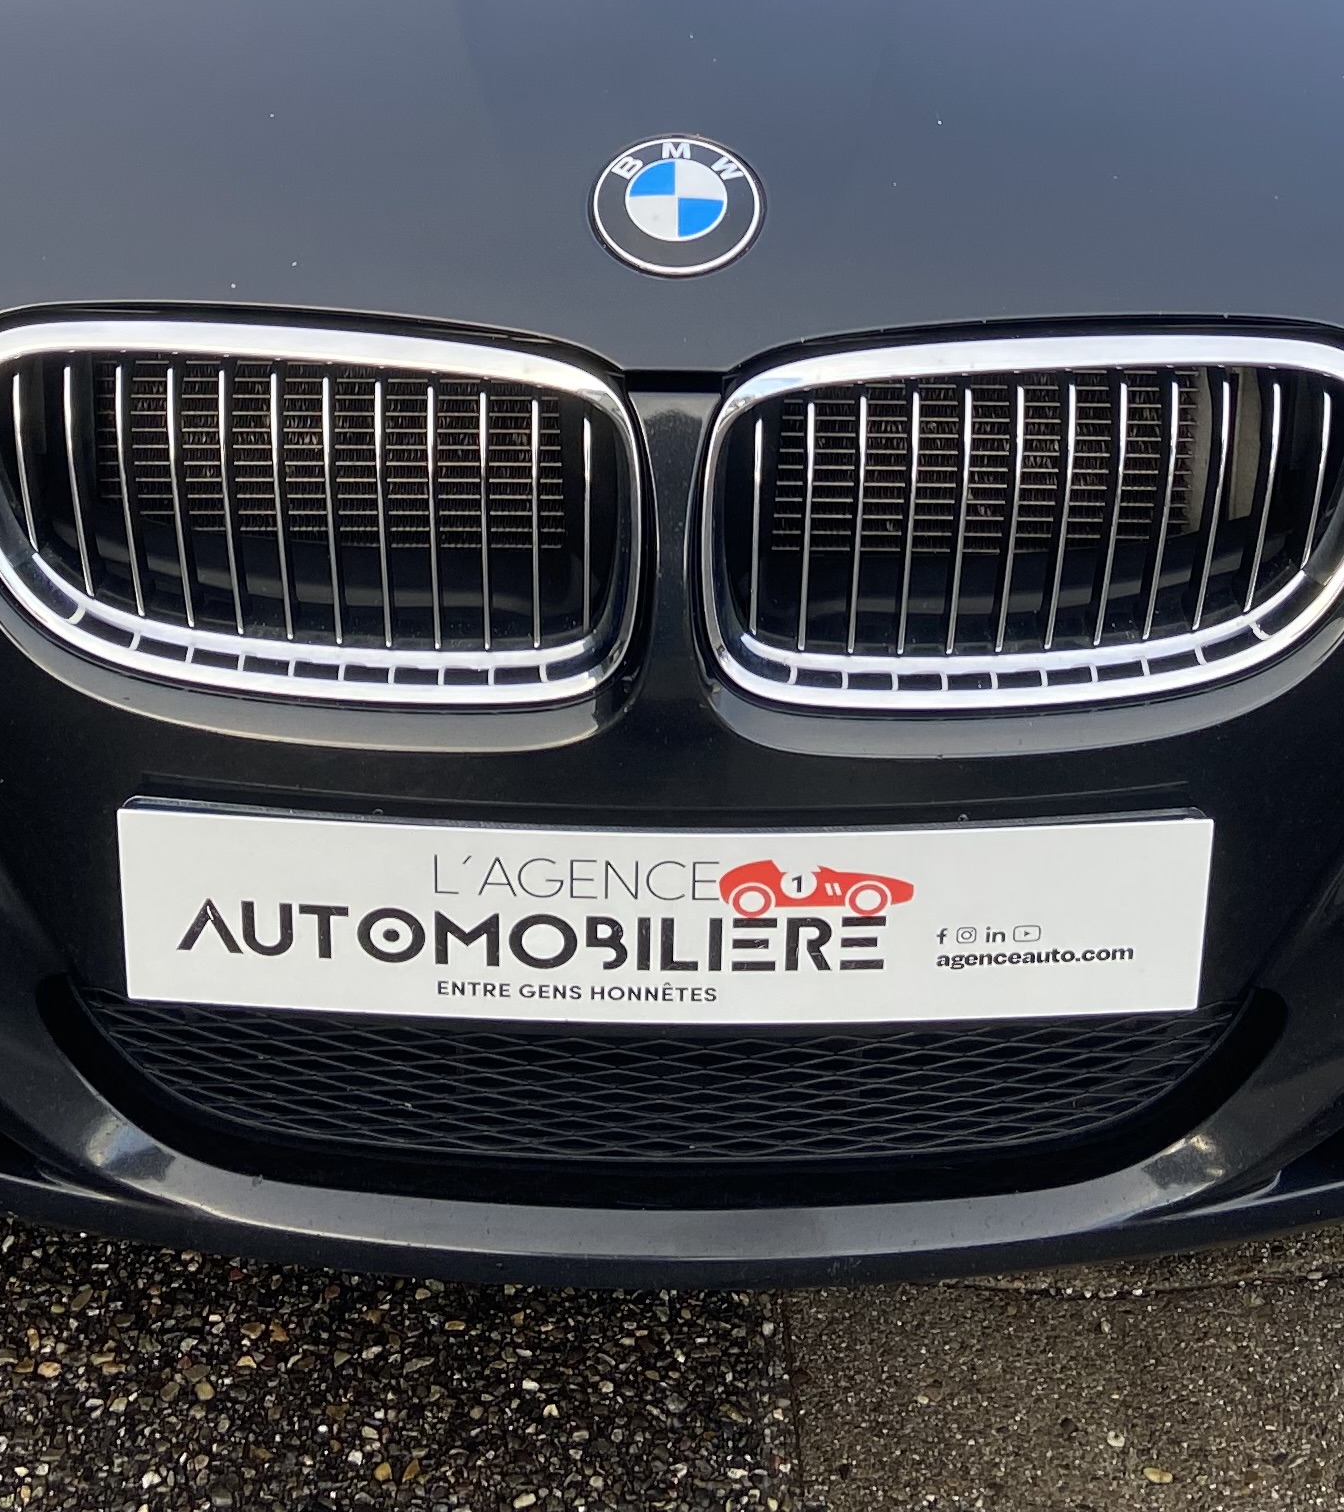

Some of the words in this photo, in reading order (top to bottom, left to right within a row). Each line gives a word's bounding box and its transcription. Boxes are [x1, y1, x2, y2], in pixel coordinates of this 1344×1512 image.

[611, 141, 744, 181] BMW
[935, 944, 1134, 970] agenceauto.com
[437, 979, 512, 999] ENTRE
[518, 982, 582, 1001] GENS
[590, 981, 718, 1004] HONNÊTES
